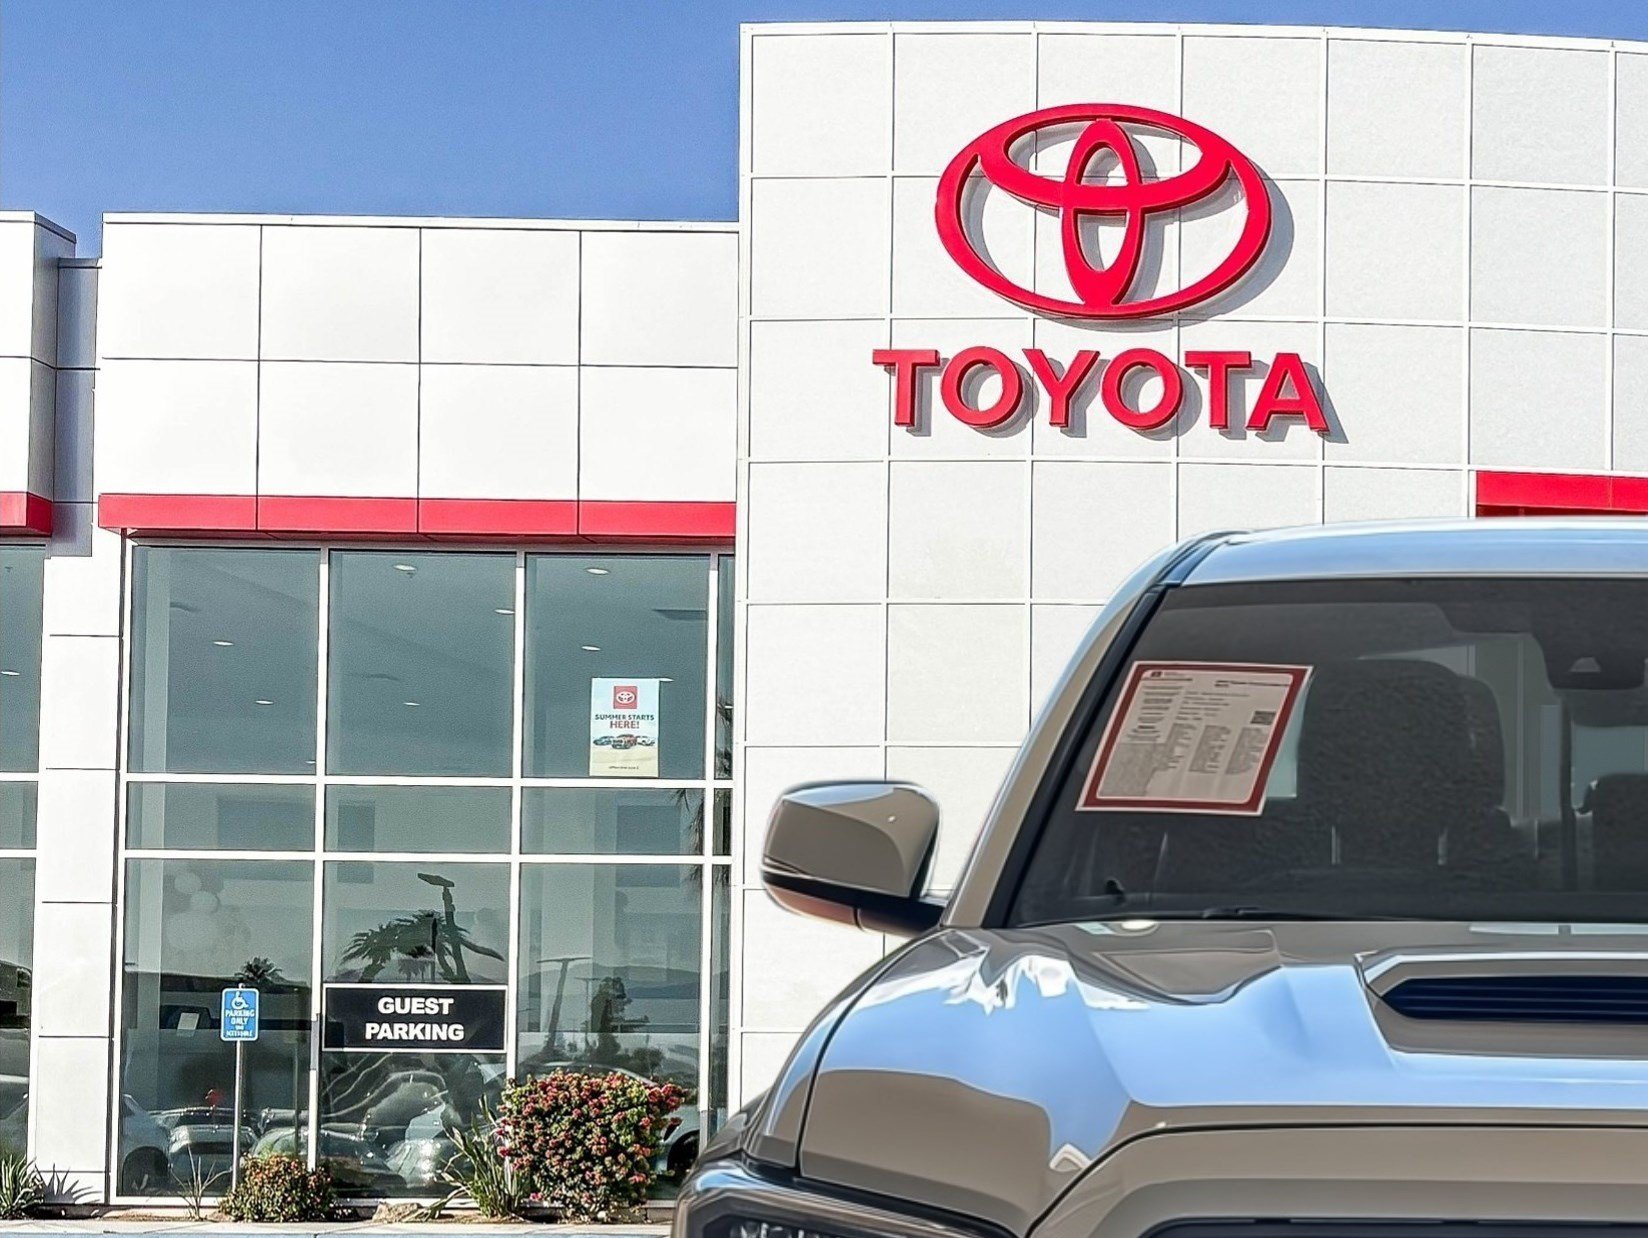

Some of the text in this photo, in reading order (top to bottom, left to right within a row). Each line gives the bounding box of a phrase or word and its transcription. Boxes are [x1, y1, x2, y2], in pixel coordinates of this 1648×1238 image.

[873, 346, 1329, 433] TOYOTA
[609, 721, 640, 729] HERE!
[377, 997, 454, 1015] GUEST
[225, 1009, 255, 1017] PARKING
[230, 1017, 249, 1025] ONLY
[365, 1023, 465, 1041] PARKING
